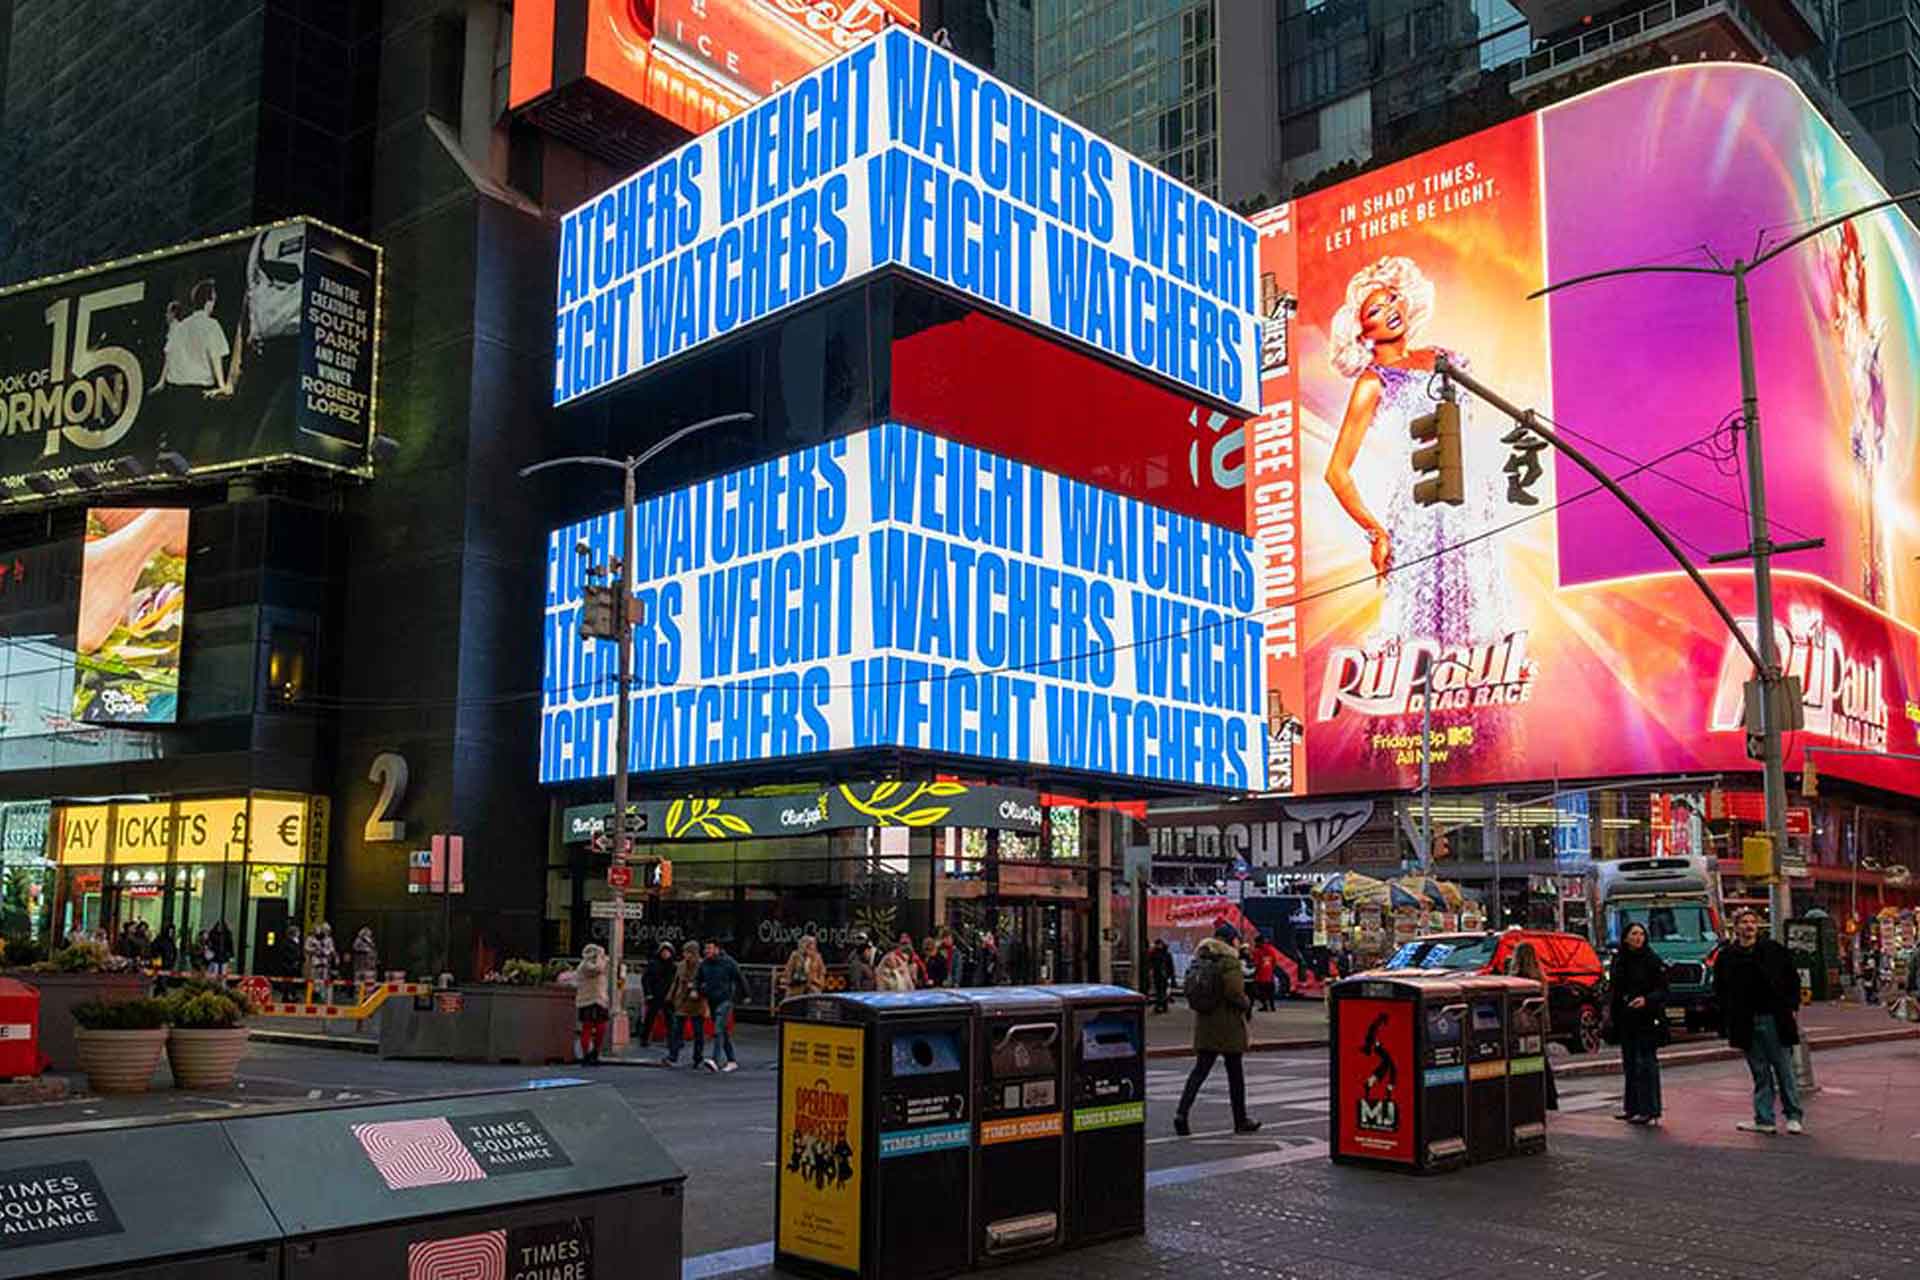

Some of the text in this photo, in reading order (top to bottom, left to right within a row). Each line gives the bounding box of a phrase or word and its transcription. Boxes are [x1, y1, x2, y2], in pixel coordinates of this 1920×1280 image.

[718, 42, 877, 226] WEIGHT
[886, 29, 1258, 316] WATCHERS WEIGHT
[1340, 204, 1357, 224] IN
[1363, 184, 1416, 217] SHADY
[1325, 227, 1353, 252] LET
[1360, 210, 1409, 242] THERE
[1416, 200, 1437, 222] BE
[641, 173, 848, 367] WATCHERS
[867, 146, 1037, 317] WEIGHT
[1045, 222, 1243, 404] WATCHERS
[308, 307, 368, 340] SOUTH
[315, 327, 360, 355] PARK
[28, 368, 49, 388] OF
[302, 375, 368, 408] ROBERT
[0, 372, 124, 437] RMON
[307, 395, 361, 425] LOPEZ
[1254, 400, 1293, 476] FREE
[634, 440, 849, 585] WATCHERS
[868, 425, 1044, 558] WEIGHT
[1058, 475, 1255, 614] WATCHERS
[699, 536, 861, 681] WEIGHT
[869, 528, 1115, 688] WATCHERS
[1130, 590, 1264, 716] WEIGHT
[1474, 682, 1534, 707] RACE
[629, 666, 831, 773] WATCHERS
[851, 657, 1036, 761] WEIGHT
[1045, 684, 1249, 790] WATCHERS
[1373, 733, 1423, 751] Fridays
[1396, 749, 1448, 766] All Nw
[365, 752, 408, 842] 2
[63, 818, 99, 849] AY
[470, 1121, 532, 1139] TIMES
[473, 1133, 549, 1153] SQUARE
[489, 1148, 553, 1165] ALLIANCE
[4, 1210, 100, 1235] ALLIANCE
[521, 1239, 580, 1266] TIMES
